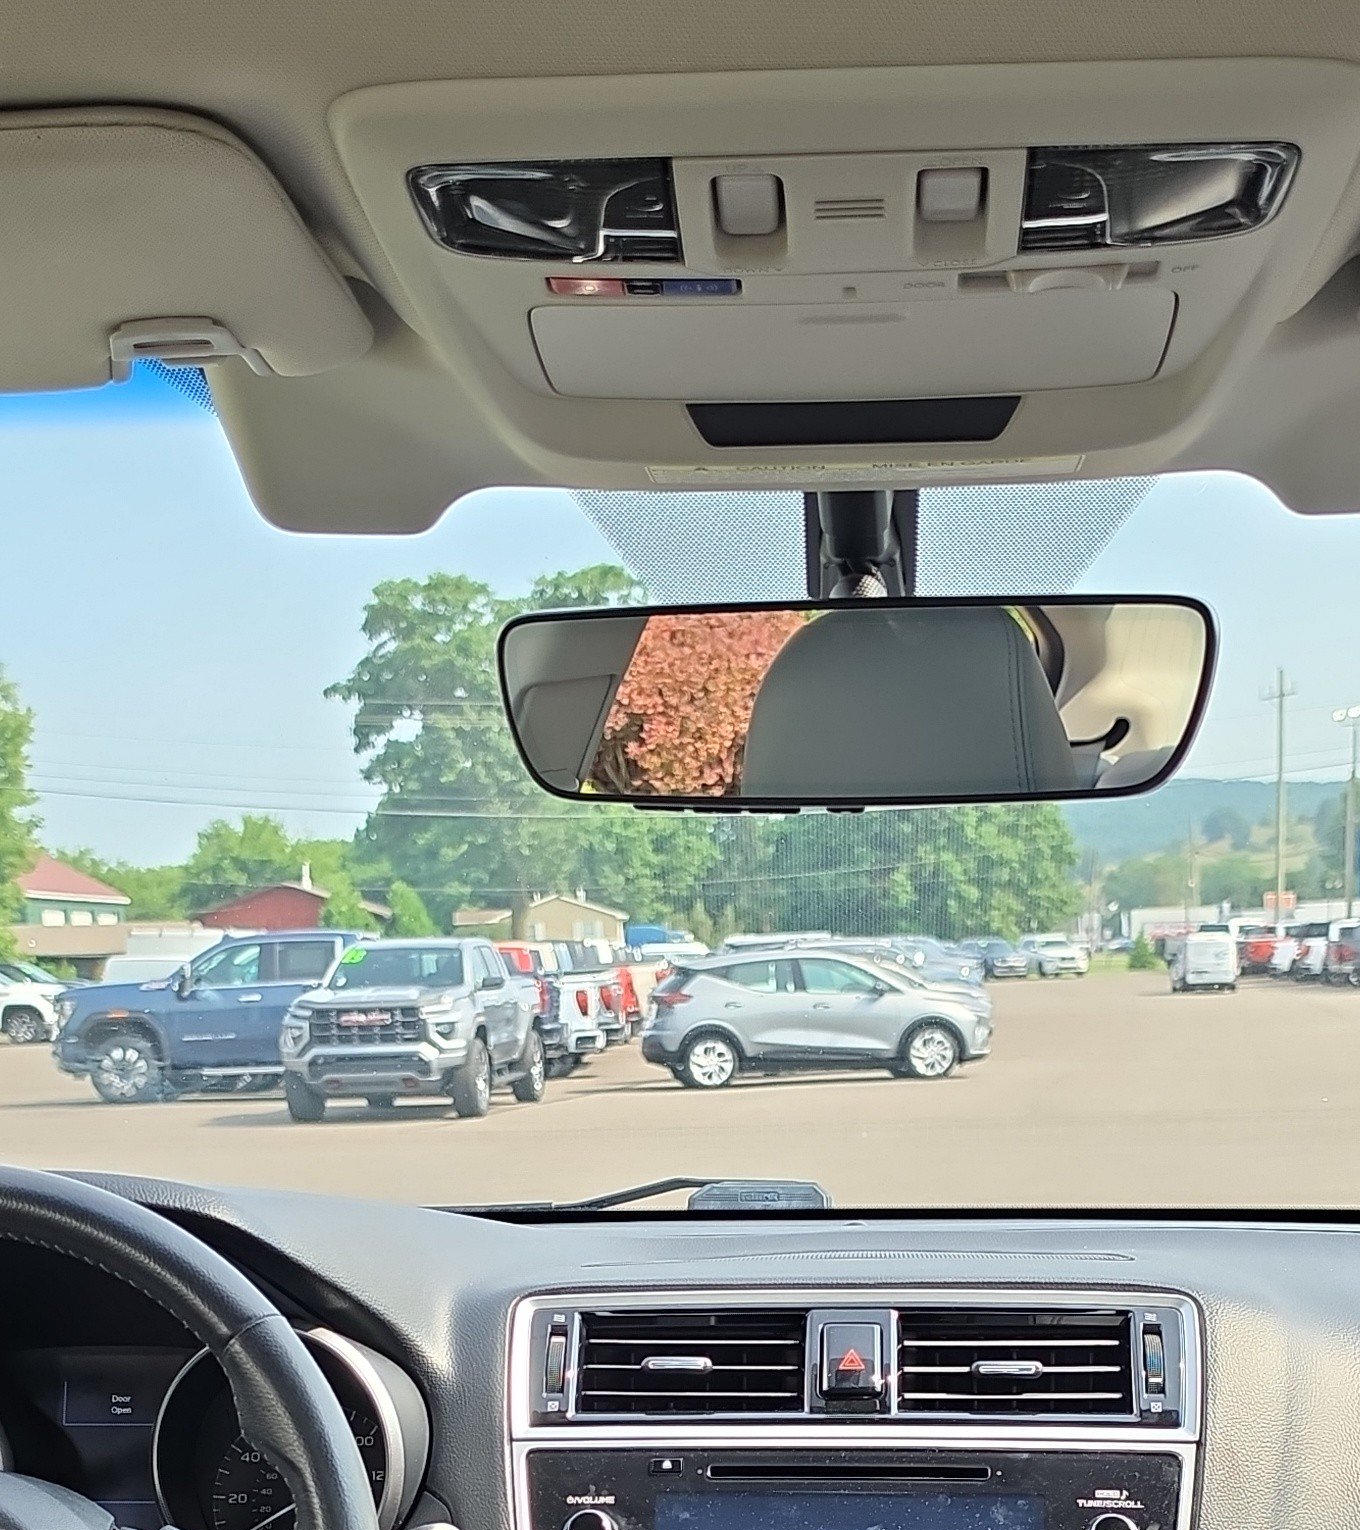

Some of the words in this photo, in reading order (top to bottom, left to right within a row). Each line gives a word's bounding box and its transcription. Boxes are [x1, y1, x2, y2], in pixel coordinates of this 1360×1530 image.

[112, 1394, 132, 1403] Door
[111, 1406, 132, 1415] Open
[240, 1452, 260, 1463] 40
[228, 1493, 247, 1504] 20
